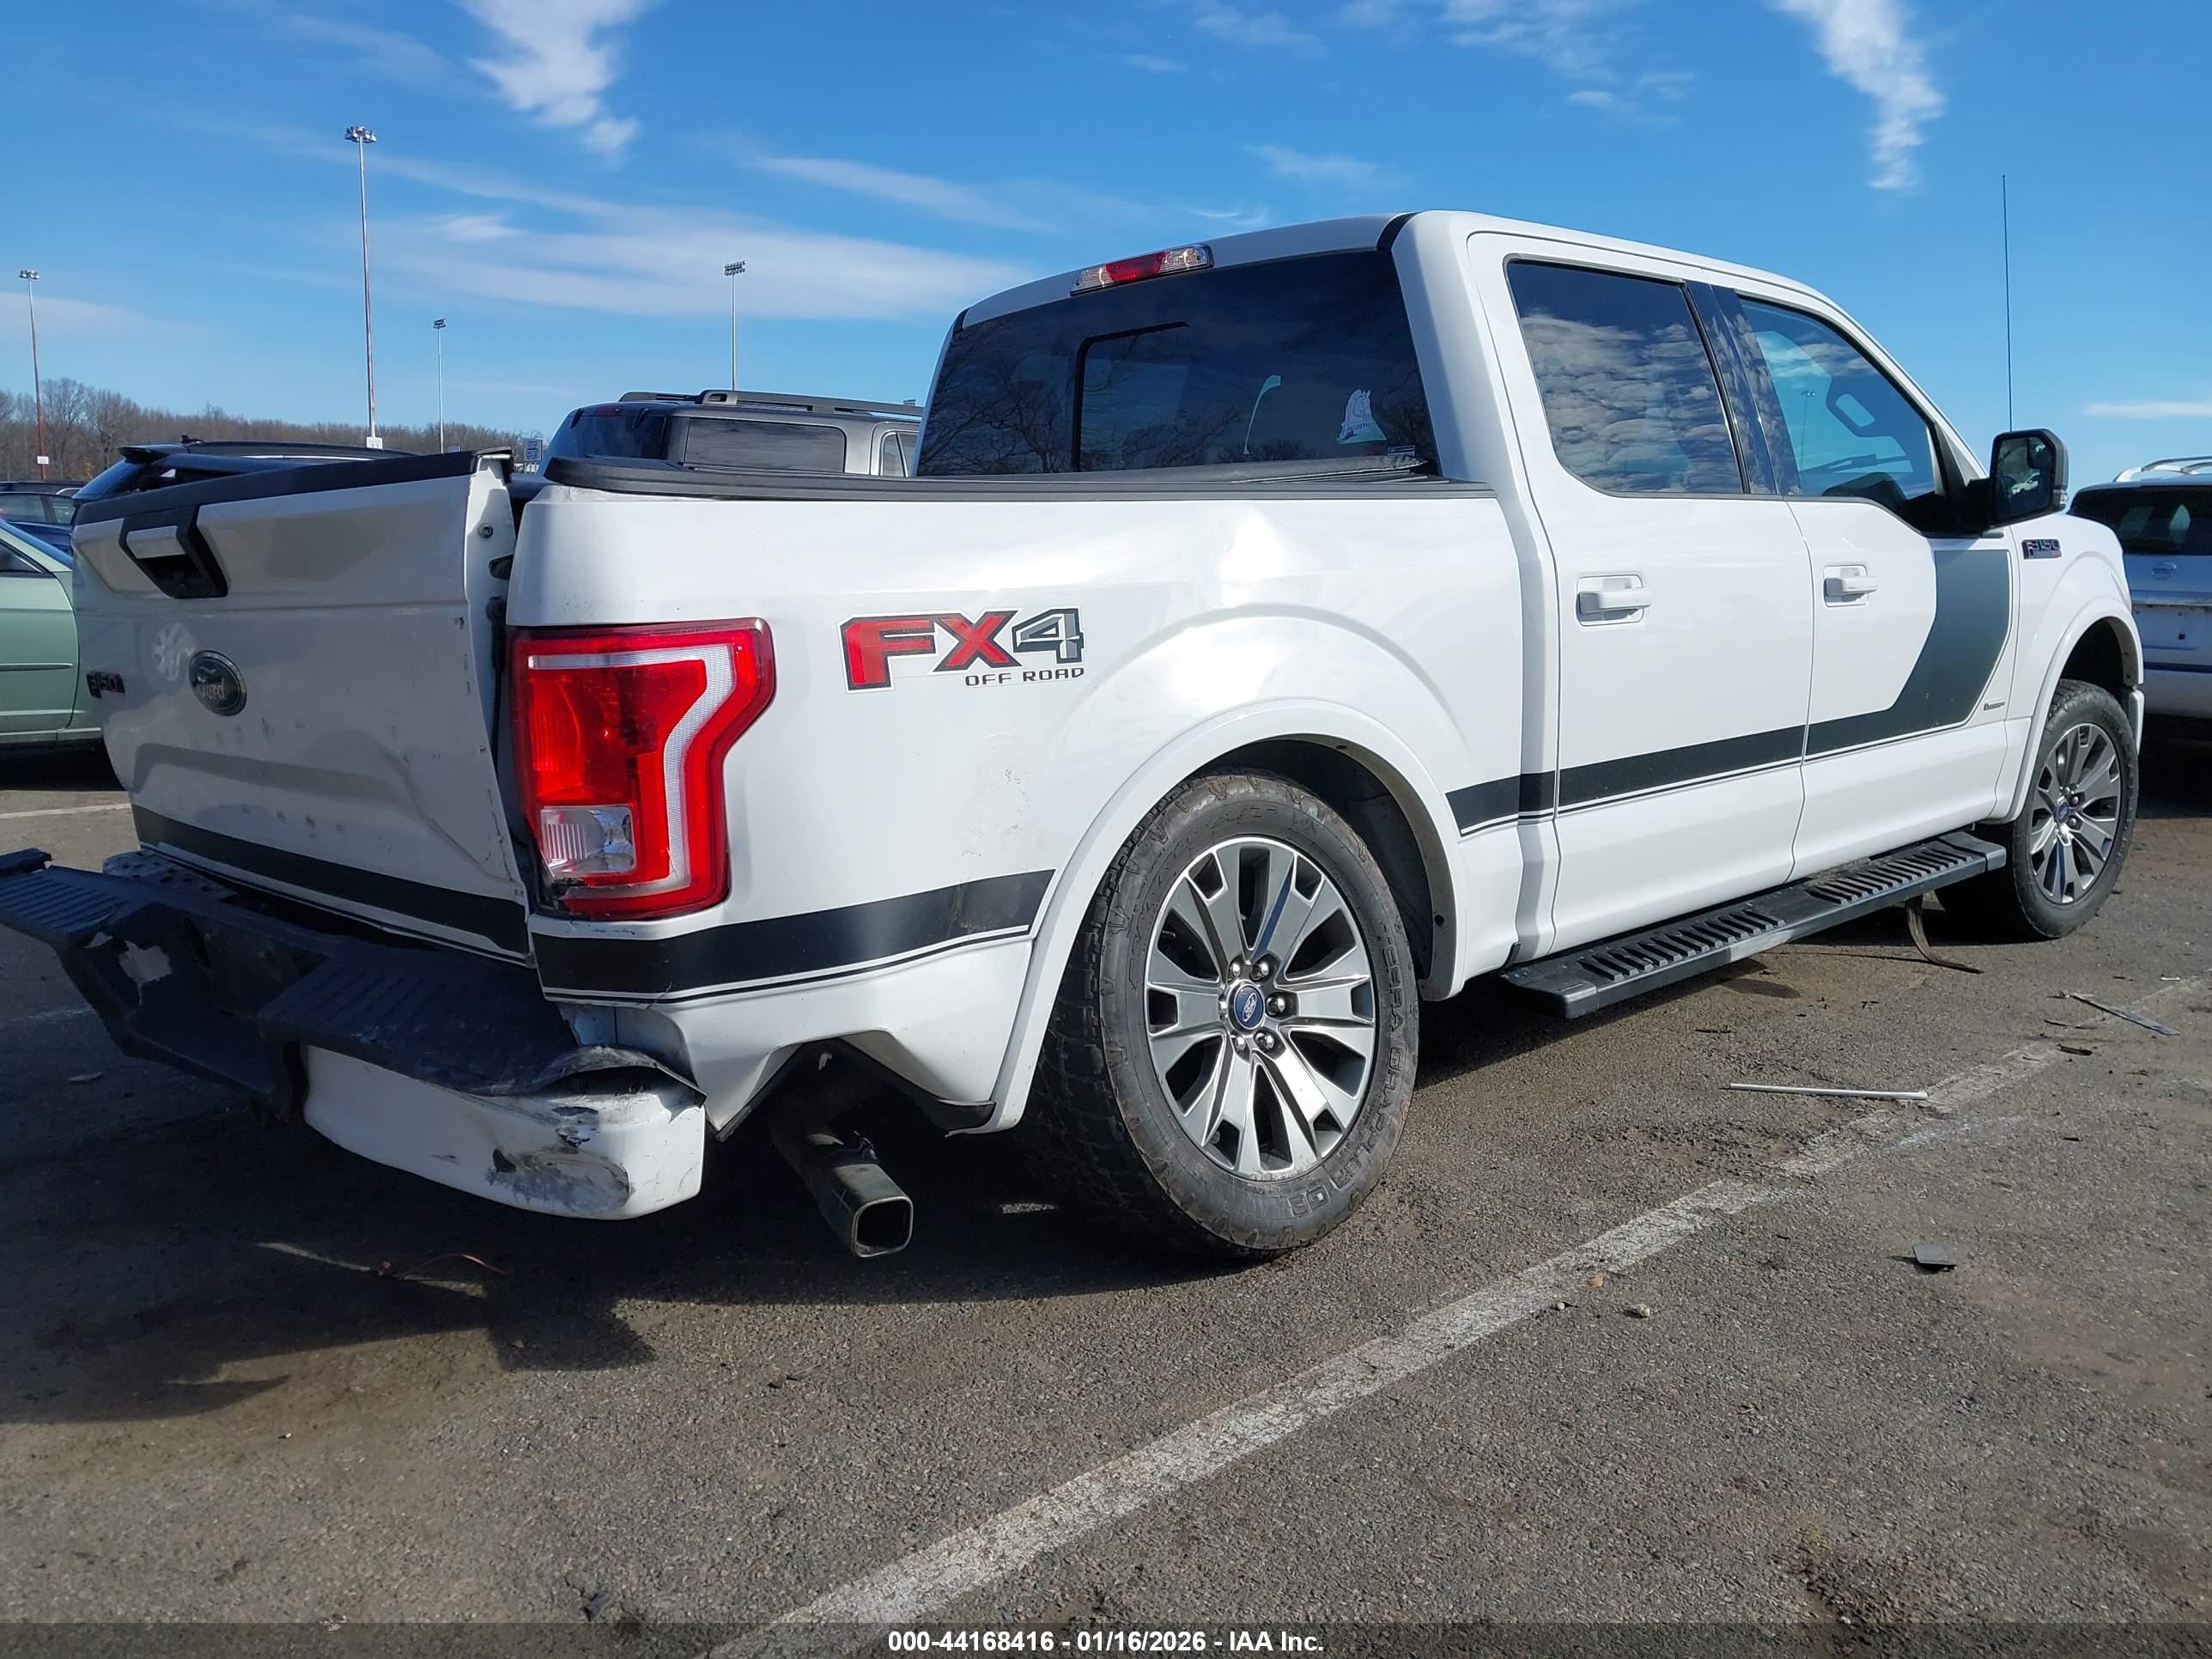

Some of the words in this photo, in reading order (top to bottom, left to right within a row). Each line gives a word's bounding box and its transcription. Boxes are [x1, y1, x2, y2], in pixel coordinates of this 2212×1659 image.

[839, 607, 1085, 691] FX4
[965, 672, 1012, 687] OFF
[1023, 667, 1085, 683] ROAD
